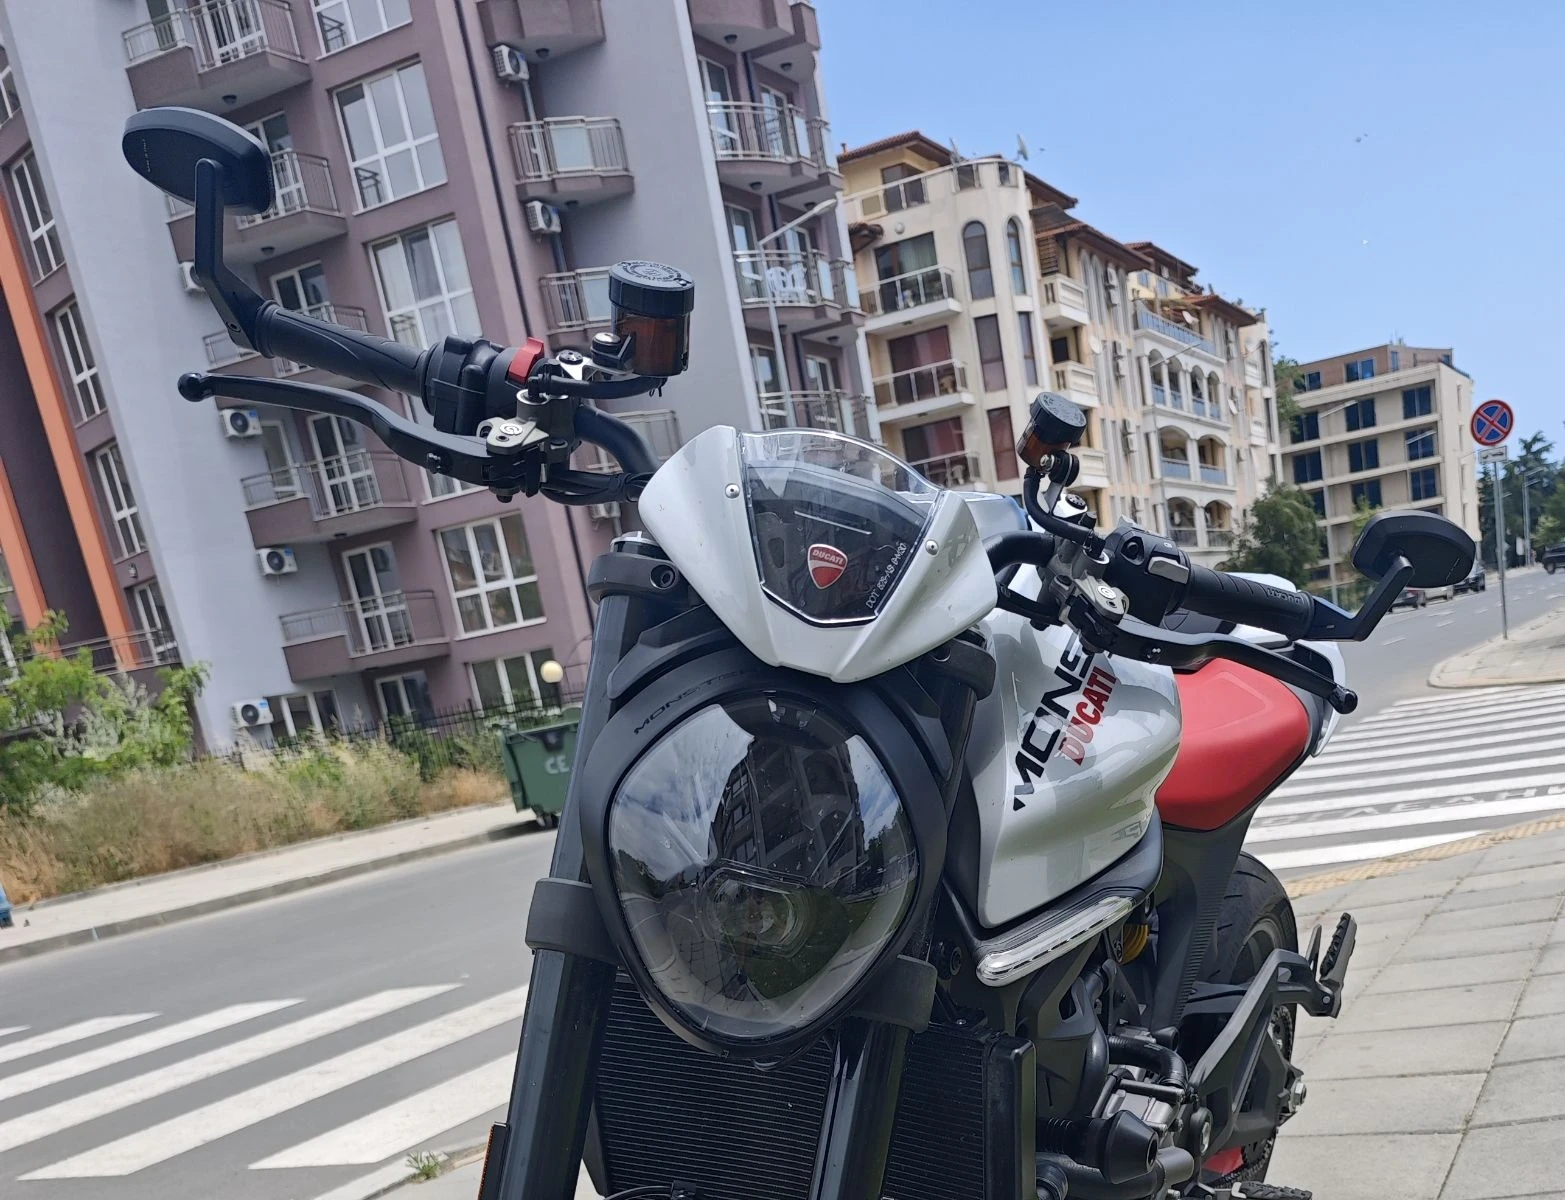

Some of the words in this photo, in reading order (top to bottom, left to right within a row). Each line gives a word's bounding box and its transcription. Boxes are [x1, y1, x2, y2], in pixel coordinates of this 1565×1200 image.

[811, 548, 846, 566] DUCATI
[865, 588, 881, 609] DOT
[1012, 631, 1098, 812] MONS
[1060, 665, 1118, 767] DUCATI
[544, 754, 570, 775] CE
